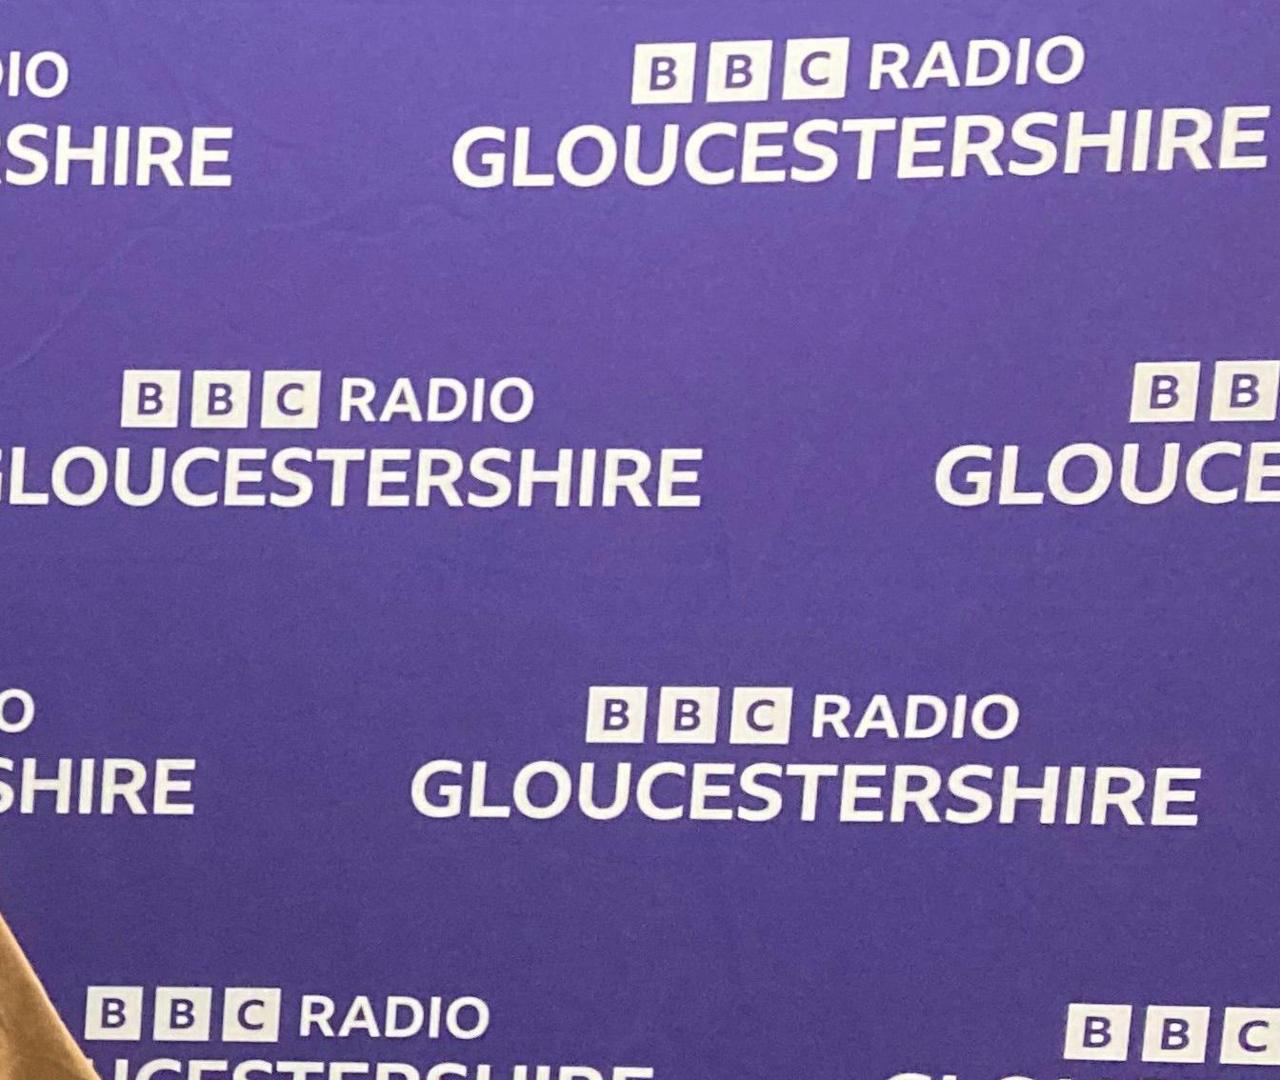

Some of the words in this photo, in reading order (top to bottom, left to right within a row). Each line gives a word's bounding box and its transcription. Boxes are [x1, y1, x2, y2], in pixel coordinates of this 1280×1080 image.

[647, 48, 833, 93] BBC
[869, 35, 1085, 91] RADIO
[452, 105, 1271, 188] GLOUCESTERSHIRE
[135, 379, 307, 418] BBC
[341, 377, 534, 425] RADIO
[600, 695, 779, 735] BBC
[812, 694, 1020, 739] RADIO
[411, 759, 1202, 826] GLOUCESTERSHIRE
[97, 994, 269, 1034] BBC
[300, 995, 489, 1040] RADIO
[1079, 1012, 1273, 1056] BBC
